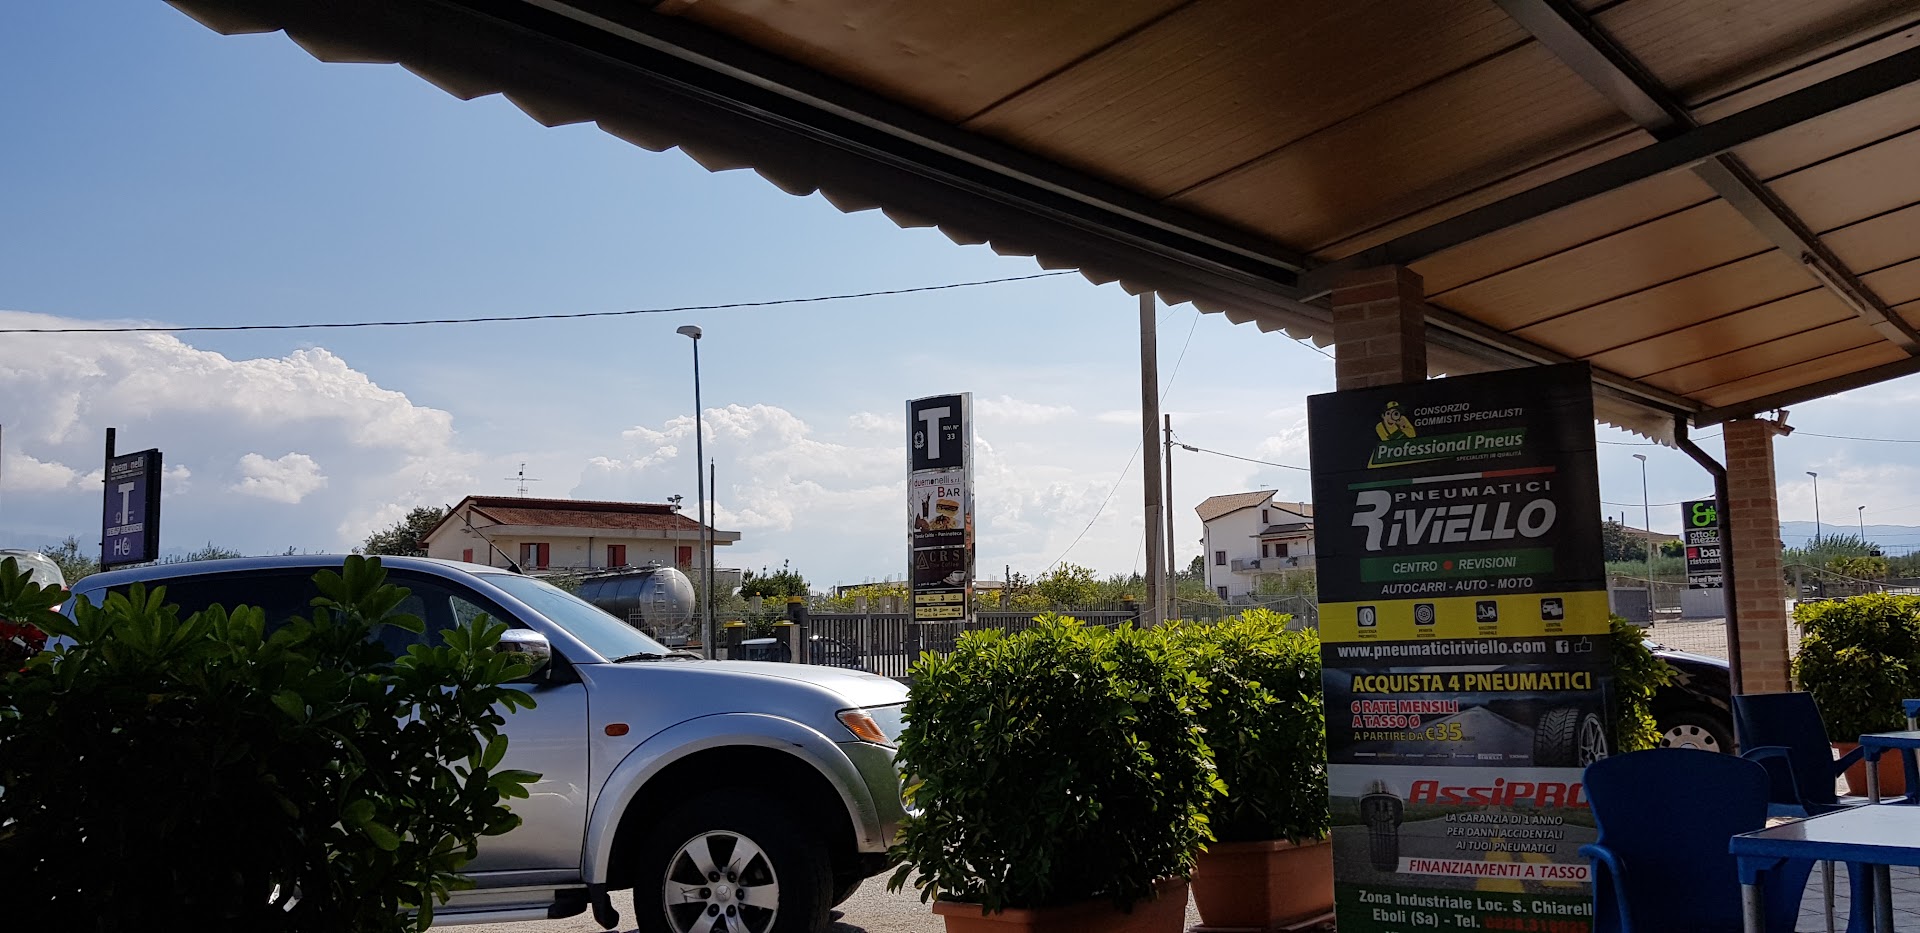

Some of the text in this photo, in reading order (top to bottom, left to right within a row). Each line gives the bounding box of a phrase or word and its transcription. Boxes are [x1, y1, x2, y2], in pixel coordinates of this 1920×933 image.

[1414, 403, 1470, 417] CONSORZIO
[1414, 408, 1523, 427] GOMMISTI SPECIALISTI
[918, 406, 951, 460] T
[946, 433, 956, 441] 33
[1377, 434, 1523, 459] Professional Pneus
[1456, 454, 1489, 462] SPECIALISTI
[937, 486, 961, 498] BAR
[1395, 480, 1551, 502] PNEUMATICI
[118, 482, 135, 525] T
[1392, 556, 1517, 574] CENTRO REVISIONI
[1381, 582, 1447, 595] AUTOCARRI
[1455, 579, 1488, 592] AUTO
[1497, 577, 1534, 589] MOTO
[1337, 640, 1546, 660] www.pneumaticiriviello.com
[1352, 671, 1591, 694] ACQUISTA 4 PNEUMATICI
[1351, 700, 1459, 714] 6 RATE MENSILI
[1352, 715, 1363, 728] A
[1365, 715, 1407, 728] TASSO
[1353, 732, 1361, 741] A
[1363, 732, 1407, 741] PARTIRE
[1408, 732, 1424, 741] DA
[1425, 723, 1463, 741] €35
[1445, 813, 1563, 826] LA GARANZIA DI 1 ANNO
[1447, 827, 1563, 840] PER DANNI ACCIDENTALI
[1456, 840, 1556, 853] AI TUOI PNEUMATICI
[1409, 859, 1587, 880] FINANZIAMENTI A TASSO
[1359, 890, 1392, 905] Zona
[1396, 892, 1472, 910] Industriale
[1477, 898, 1508, 912] Loc.
[1513, 900, 1527, 913] S.
[1373, 908, 1406, 923] Eboli
[1411, 910, 1439, 927] (Sa)
[1455, 914, 1481, 928] Tel.
